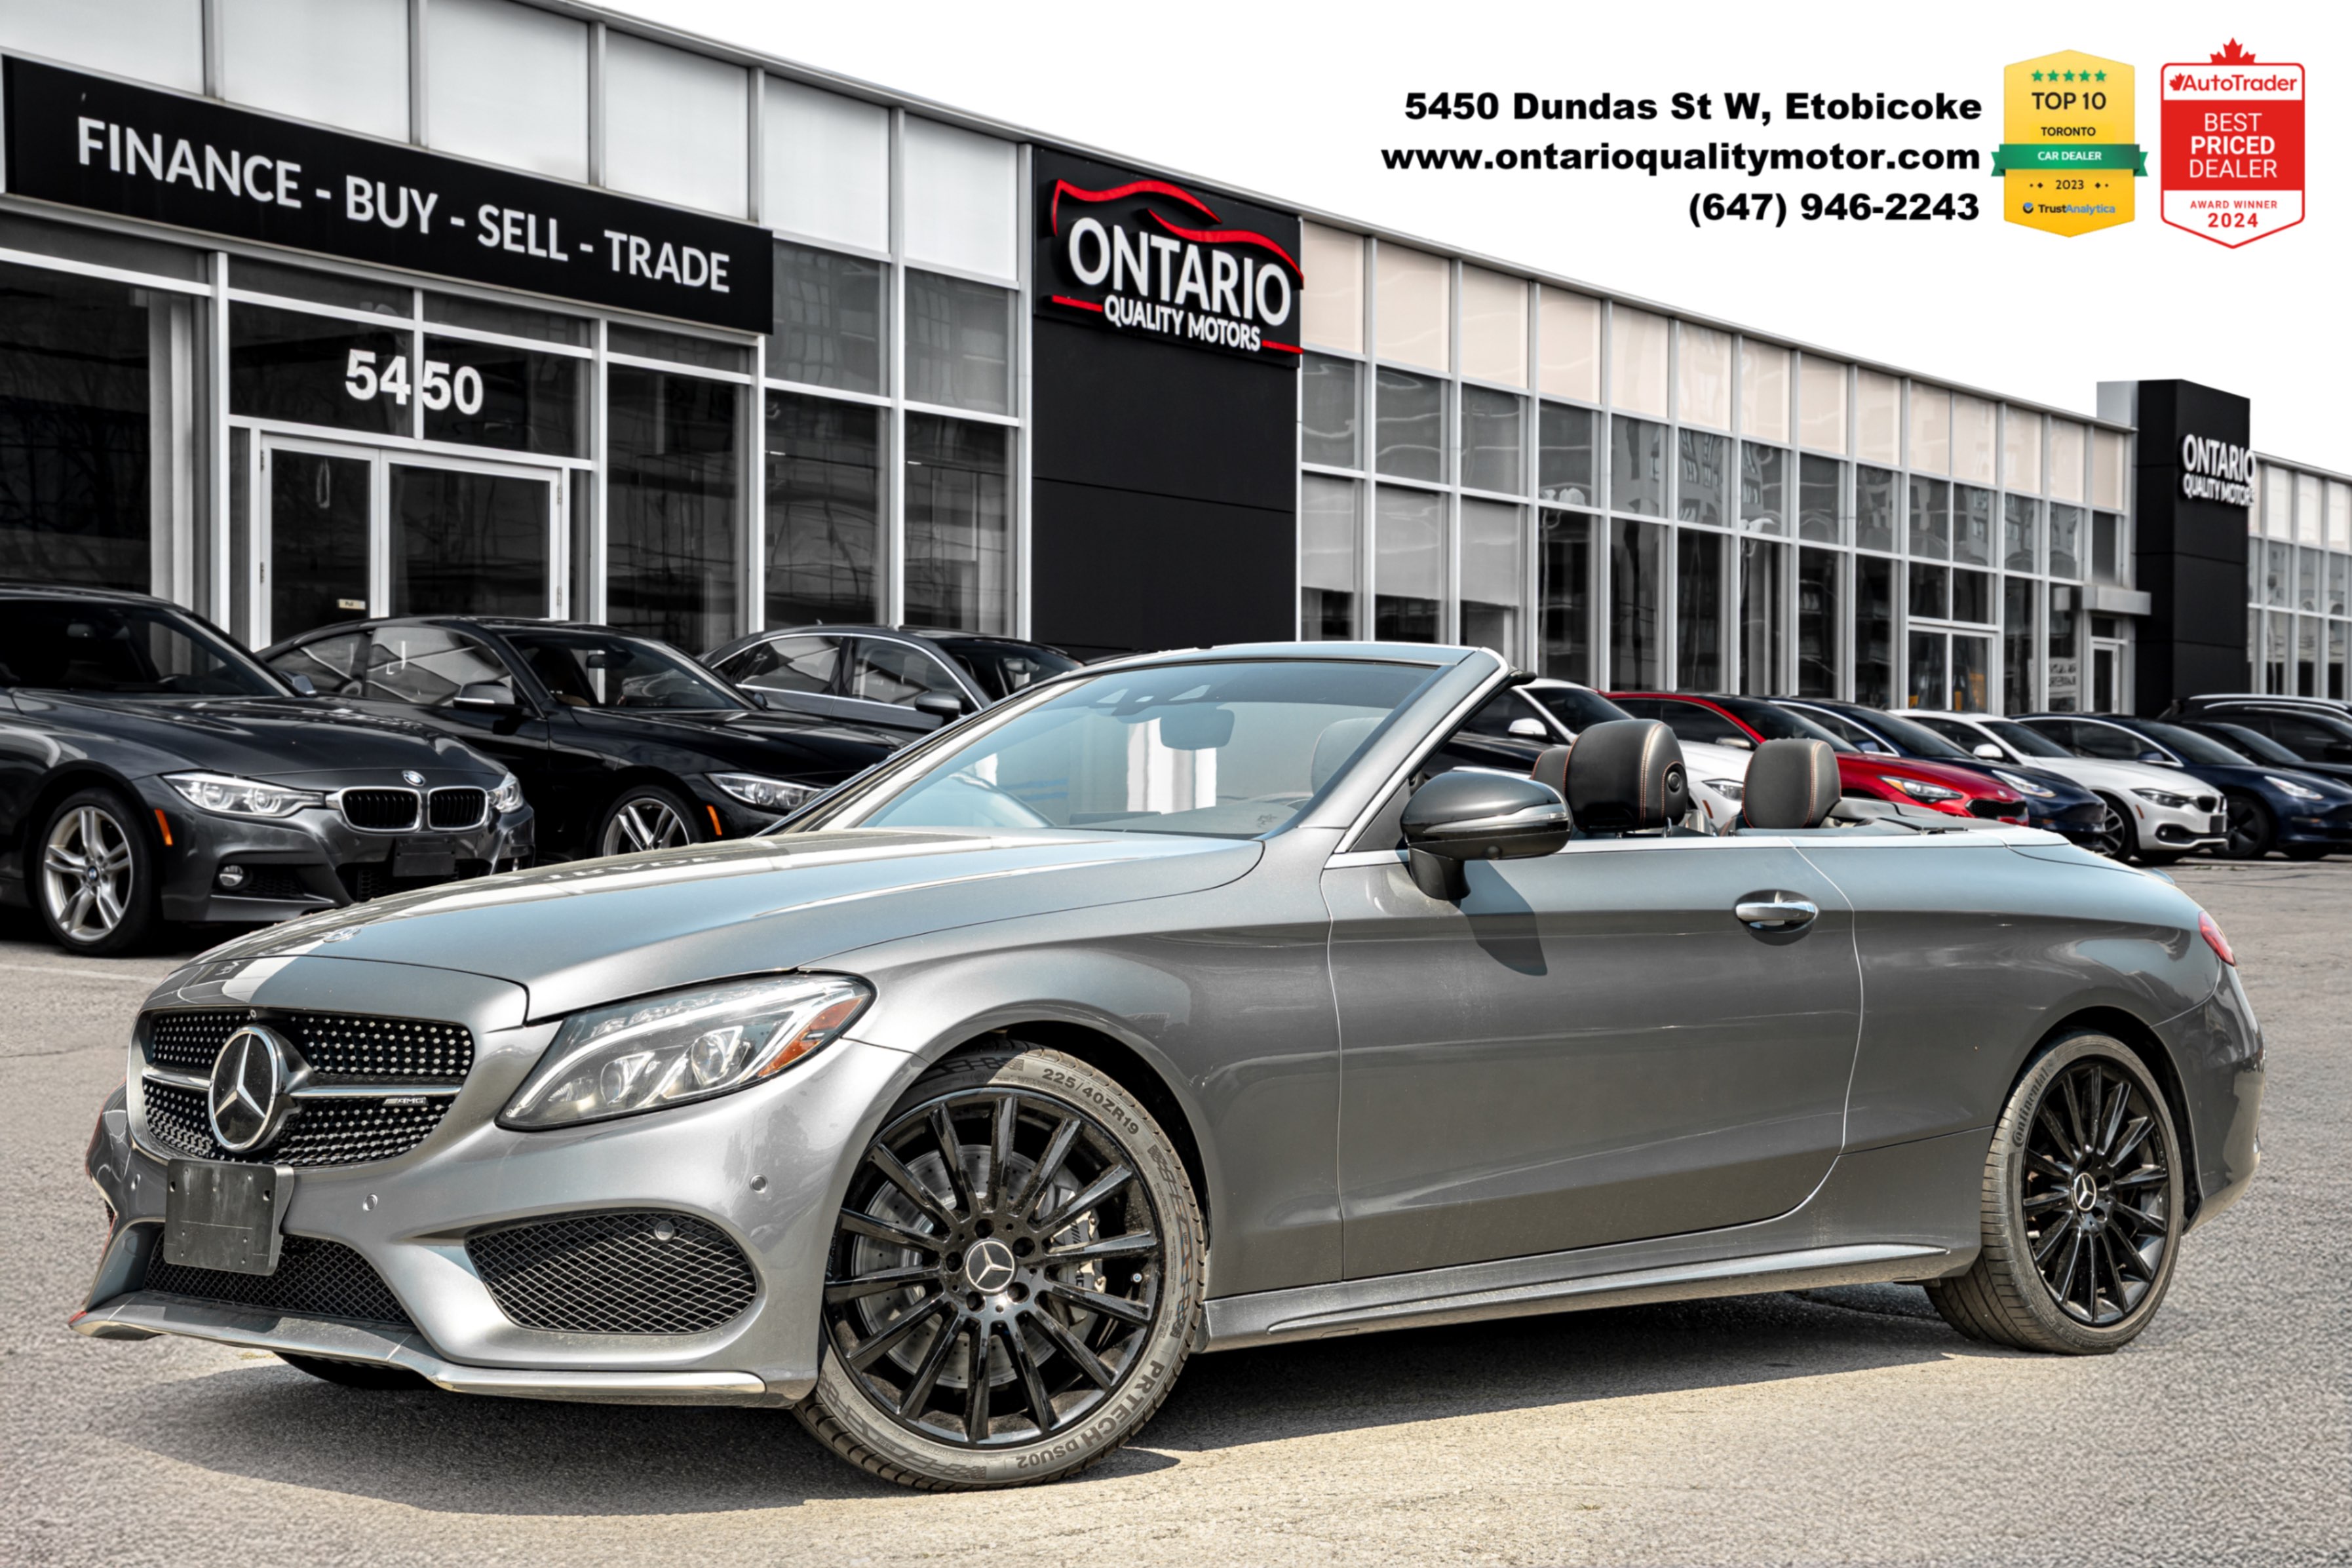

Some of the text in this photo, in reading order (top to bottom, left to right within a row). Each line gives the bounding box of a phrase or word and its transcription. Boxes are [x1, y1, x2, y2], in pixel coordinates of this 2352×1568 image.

[78, 117, 302, 208] FINANCE
[346, 175, 438, 234] BUY
[478, 204, 568, 261] SELL
[604, 229, 729, 293] TRADE
[1069, 217, 1291, 326] ONTARIO
[1104, 294, 1261, 351] QUALITY MOTORS
[345, 349, 484, 415] 5450
[2183, 434, 2256, 485] ONTARIO
[2183, 473, 2221, 500] QUALITY
[1042, 1069, 1139, 1135] 225/40ZR19
[2013, 1066, 2049, 1147] Continental
[1016, 1360, 1165, 1468] PRTECH DSU02
